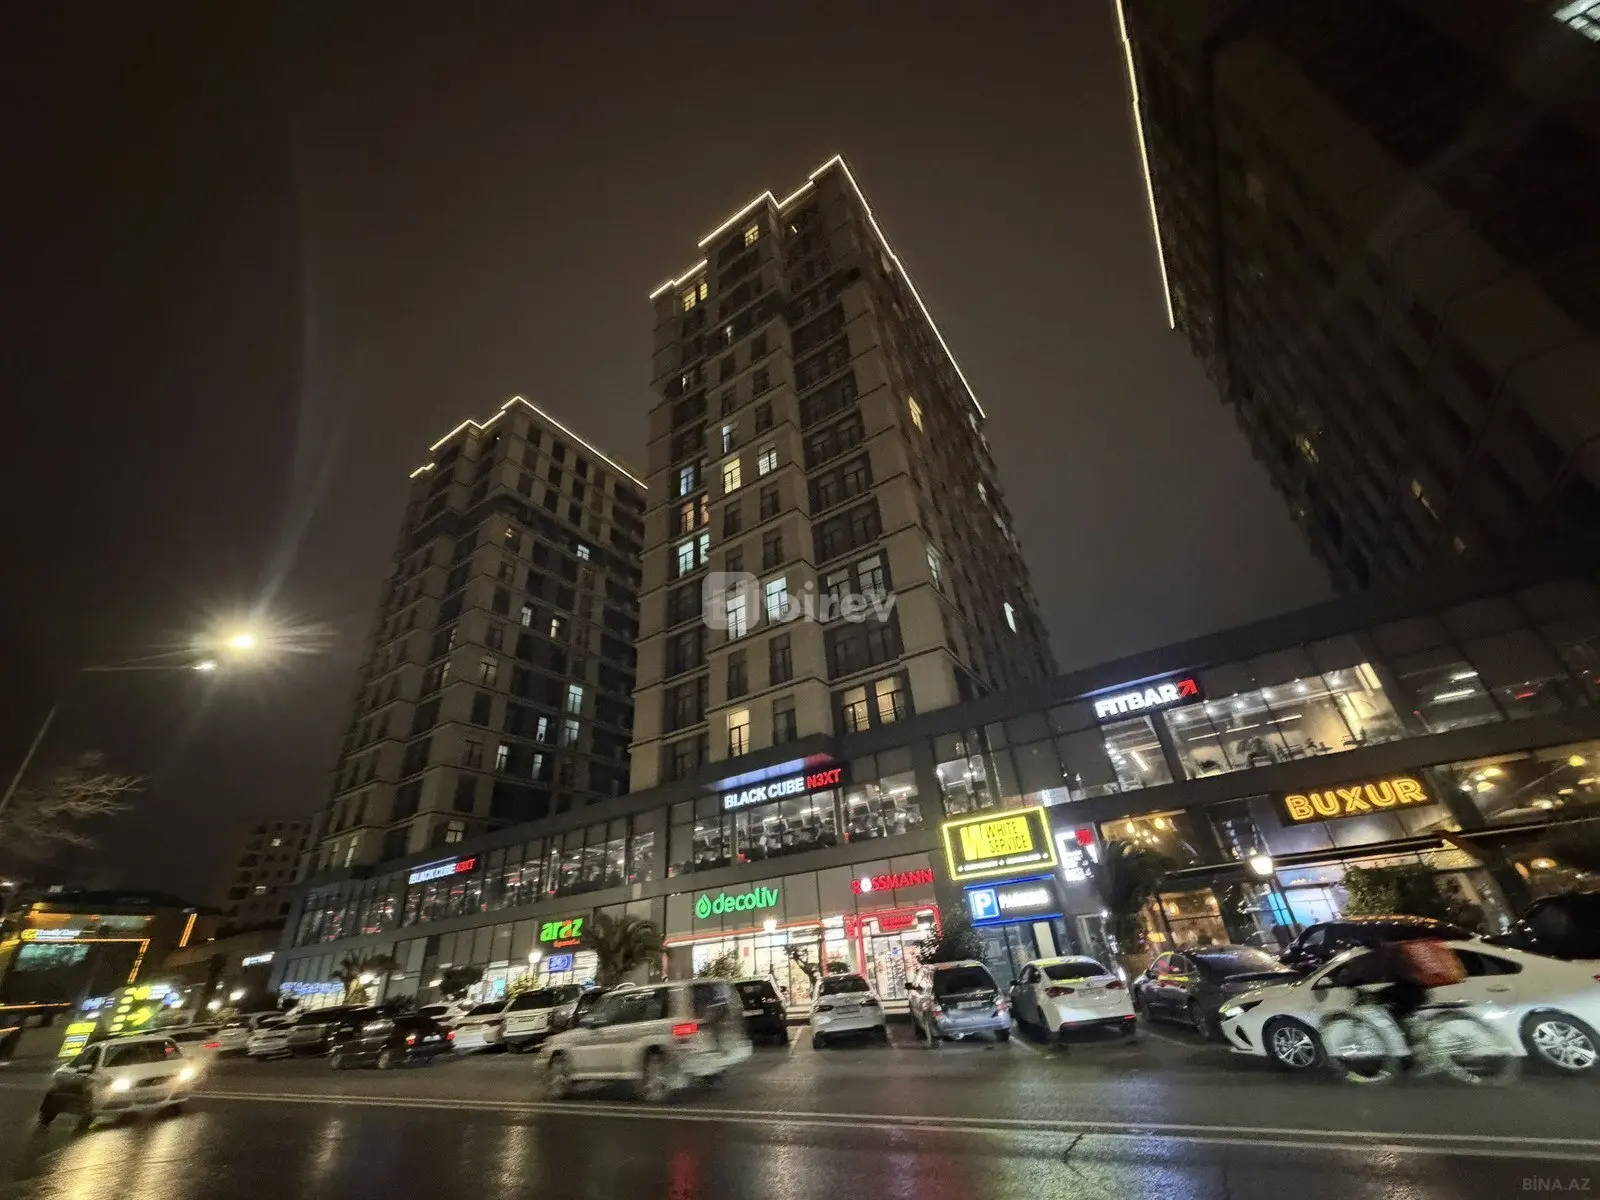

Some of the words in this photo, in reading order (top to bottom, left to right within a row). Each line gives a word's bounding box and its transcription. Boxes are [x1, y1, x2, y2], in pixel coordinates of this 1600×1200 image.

[1094, 683, 1180, 719] FITBAR
[723, 786, 768, 809] BLACK
[767, 776, 806, 798] CUBE
[806, 768, 842, 789] N3XT
[1284, 778, 1428, 821] BUXUR
[986, 821, 1019, 839] WHITE
[988, 835, 1028, 854] SERVICE
[850, 868, 935, 896] ROSSMANN
[973, 892, 993, 917] P
[540, 918, 584, 942] araz
